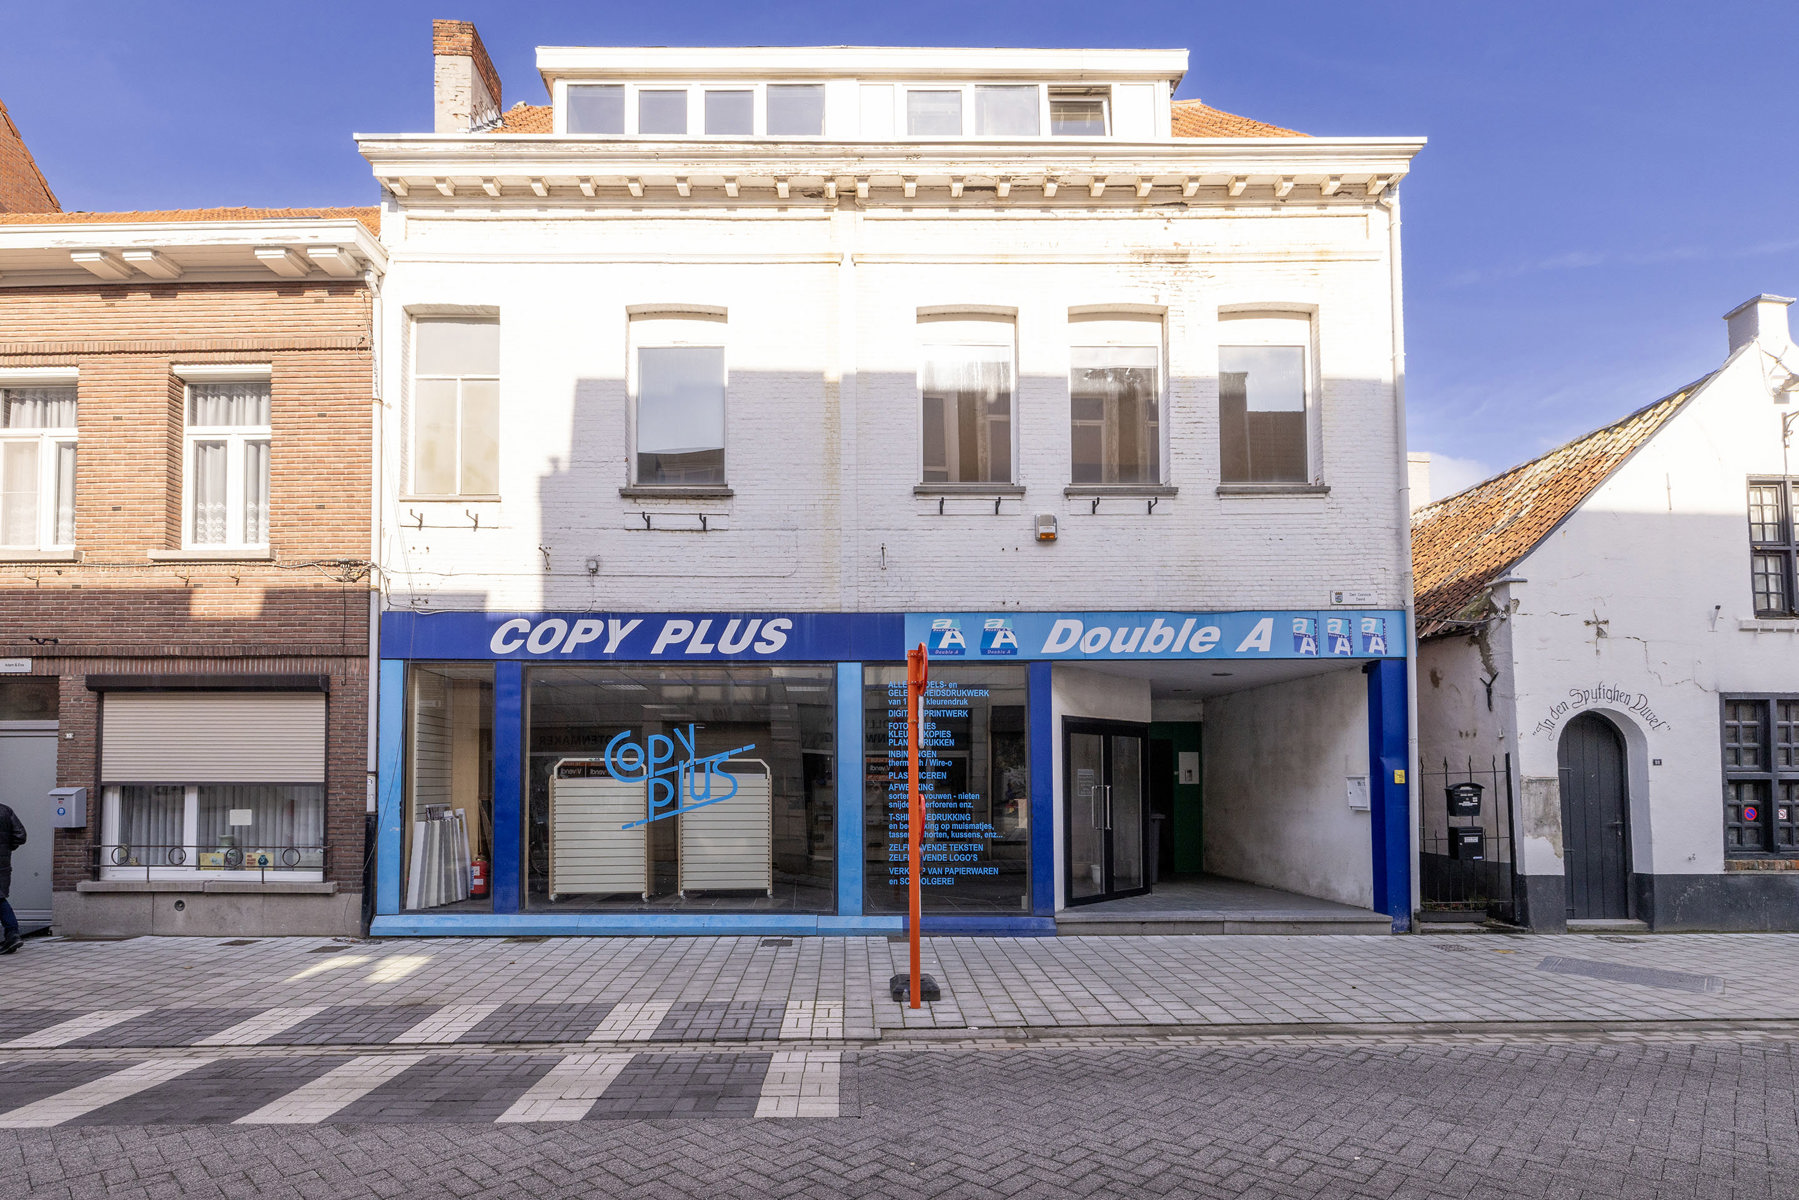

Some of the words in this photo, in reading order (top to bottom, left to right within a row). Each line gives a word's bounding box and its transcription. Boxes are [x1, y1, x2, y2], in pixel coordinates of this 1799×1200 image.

[489, 618, 644, 654] COPY
[650, 618, 793, 655] PLUS
[1040, 617, 1221, 654] Double
[1235, 617, 1275, 654] A
[888, 681, 908, 689] ALLE
[888, 689, 990, 697] GELEHEIDSDRUKWERK
[902, 698, 907, 706] 1
[926, 698, 969, 706] kleurendruk
[924, 710, 969, 718] PRINTWERK
[1549, 701, 1570, 720] den
[888, 758, 924, 767] thermh
[929, 758, 953, 767] Wire-o
[925, 800, 958, 809] erforeren
[924, 813, 971, 822] EDRUKKING
[940, 824, 951, 832] op
[951, 822, 995, 832] muismatjes,
[950, 831, 983, 840] kussens,
[949, 844, 984, 852] TEKSTEN
[949, 854, 978, 862] LOGO'S
[927, 867, 944, 875] VAN
[944, 867, 999, 875] PAPIERWAREN
[899, 877, 955, 886] SCOLGEREI
